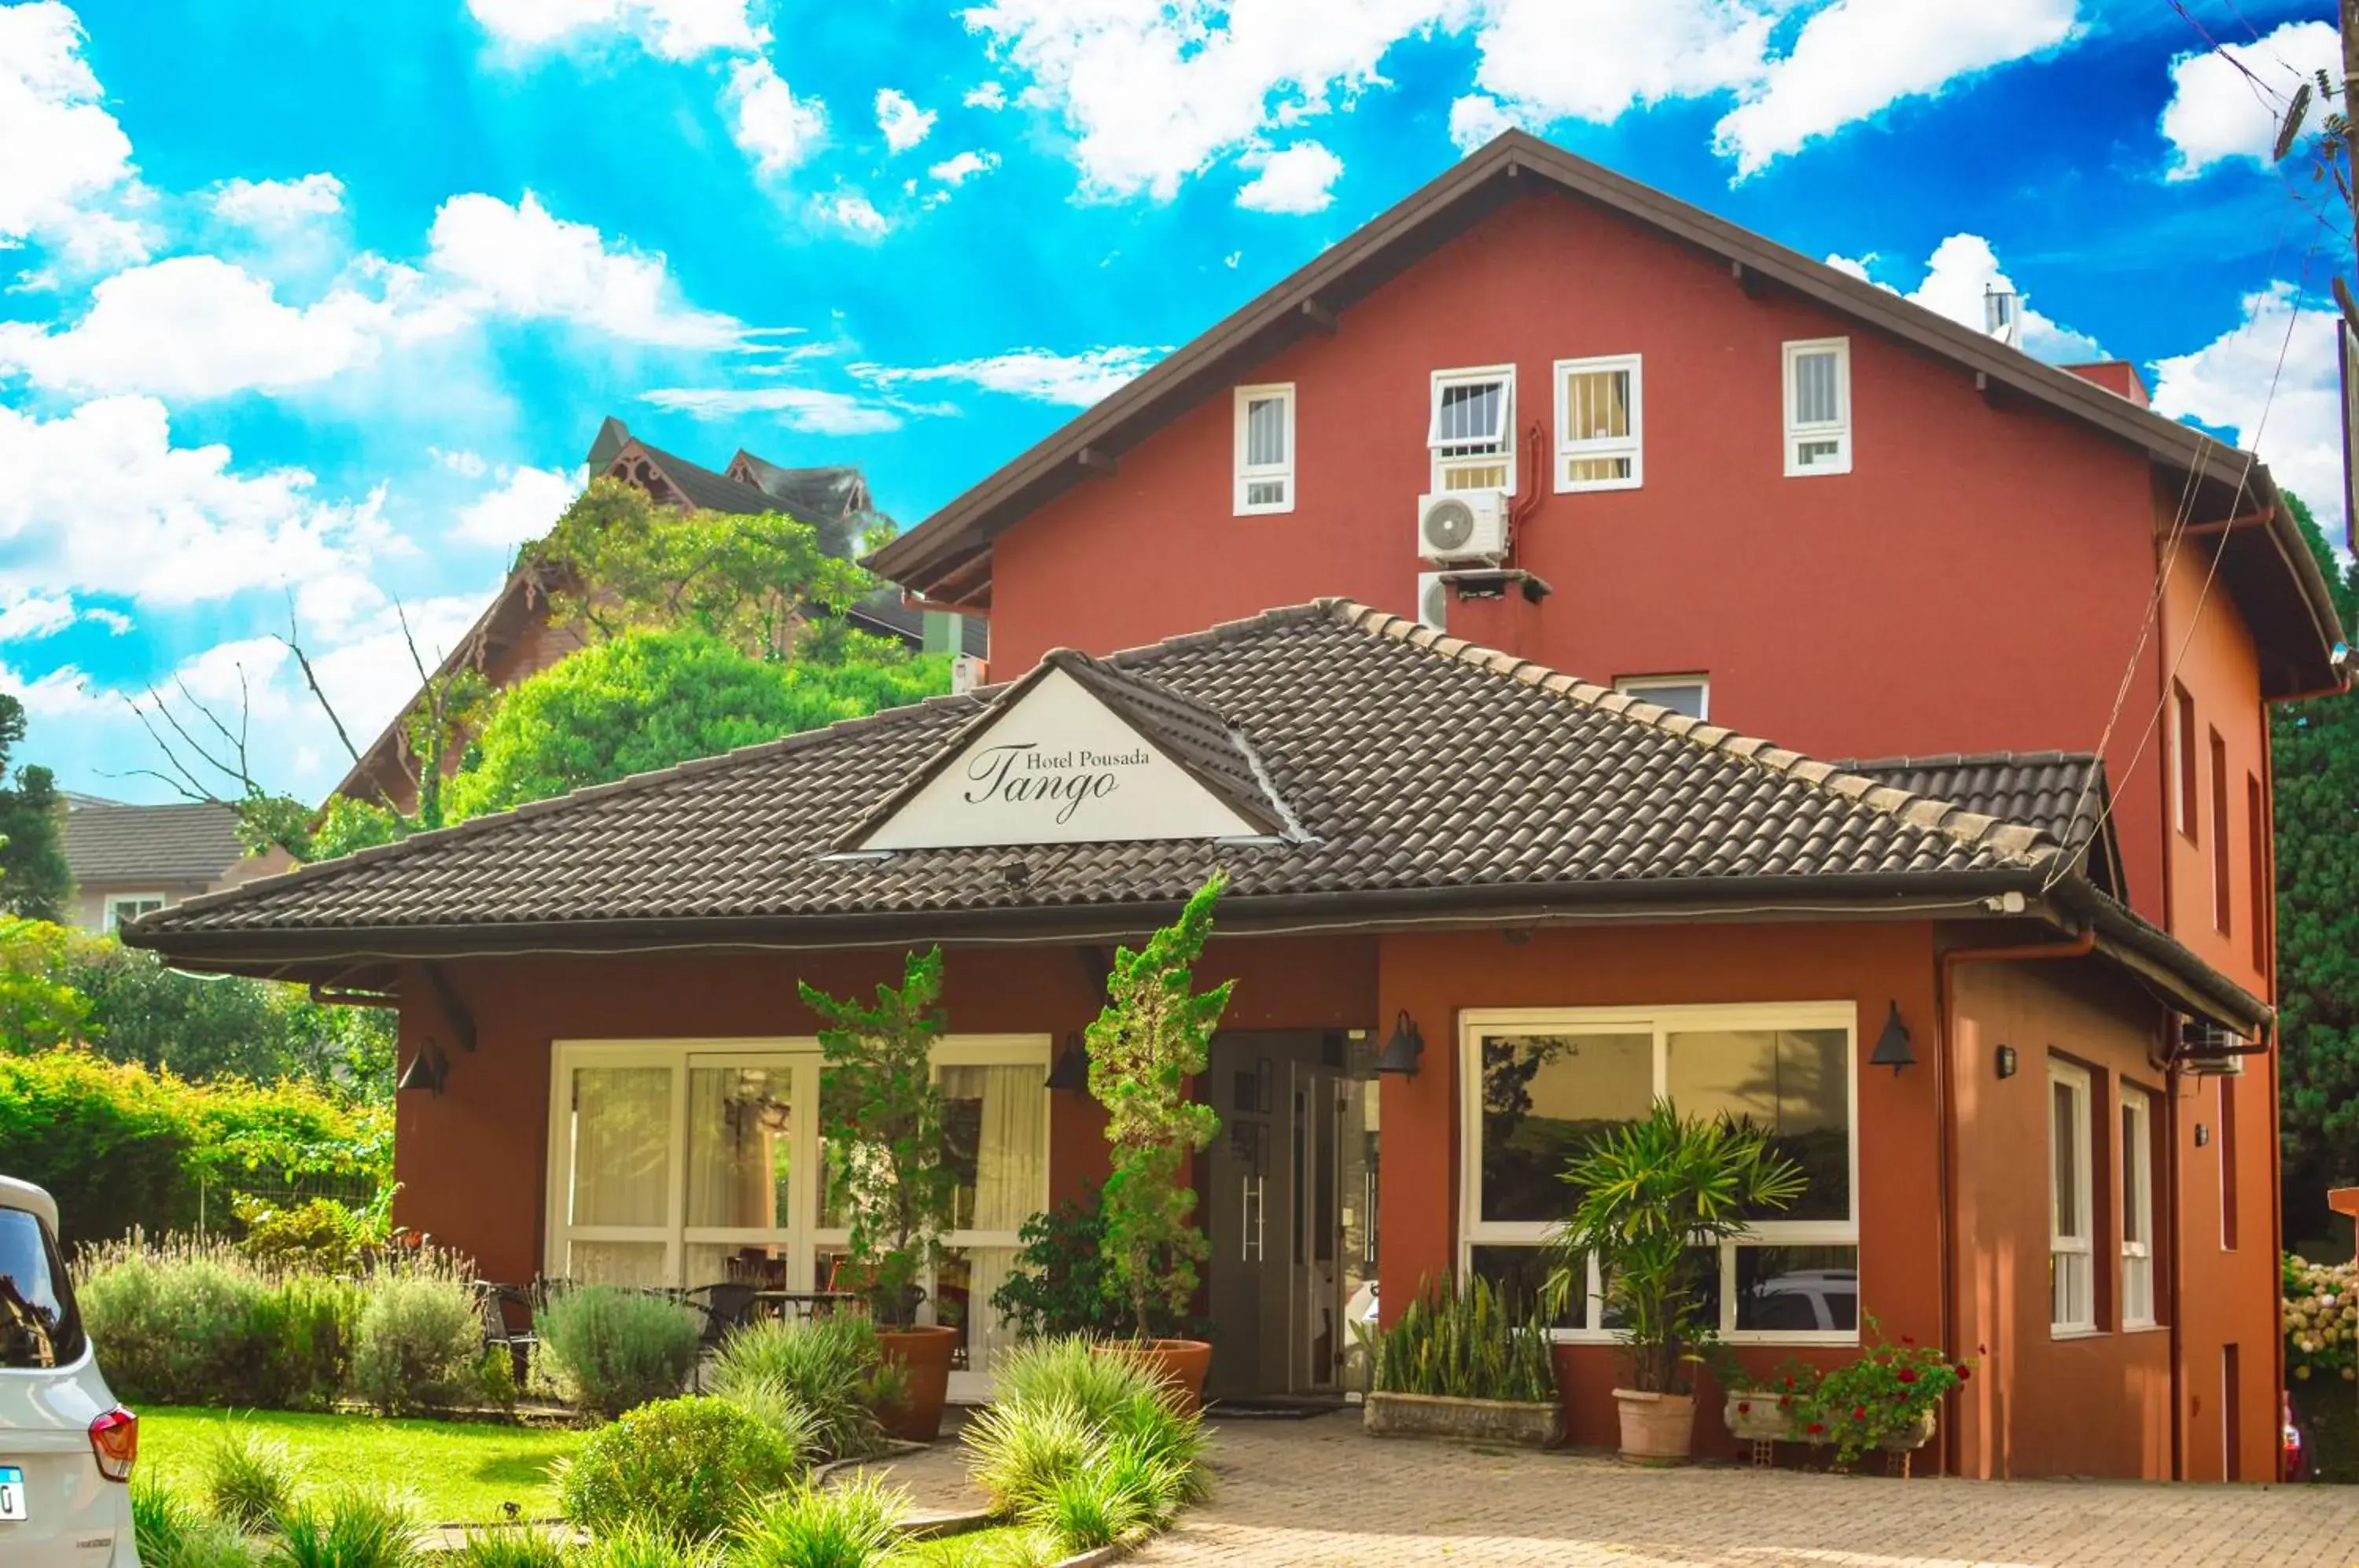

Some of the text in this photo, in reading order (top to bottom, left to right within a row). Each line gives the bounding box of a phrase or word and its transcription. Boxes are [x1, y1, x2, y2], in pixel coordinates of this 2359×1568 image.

[964, 742, 1120, 825] Tango
[1027, 749, 1150, 770] Hotel Pousada
